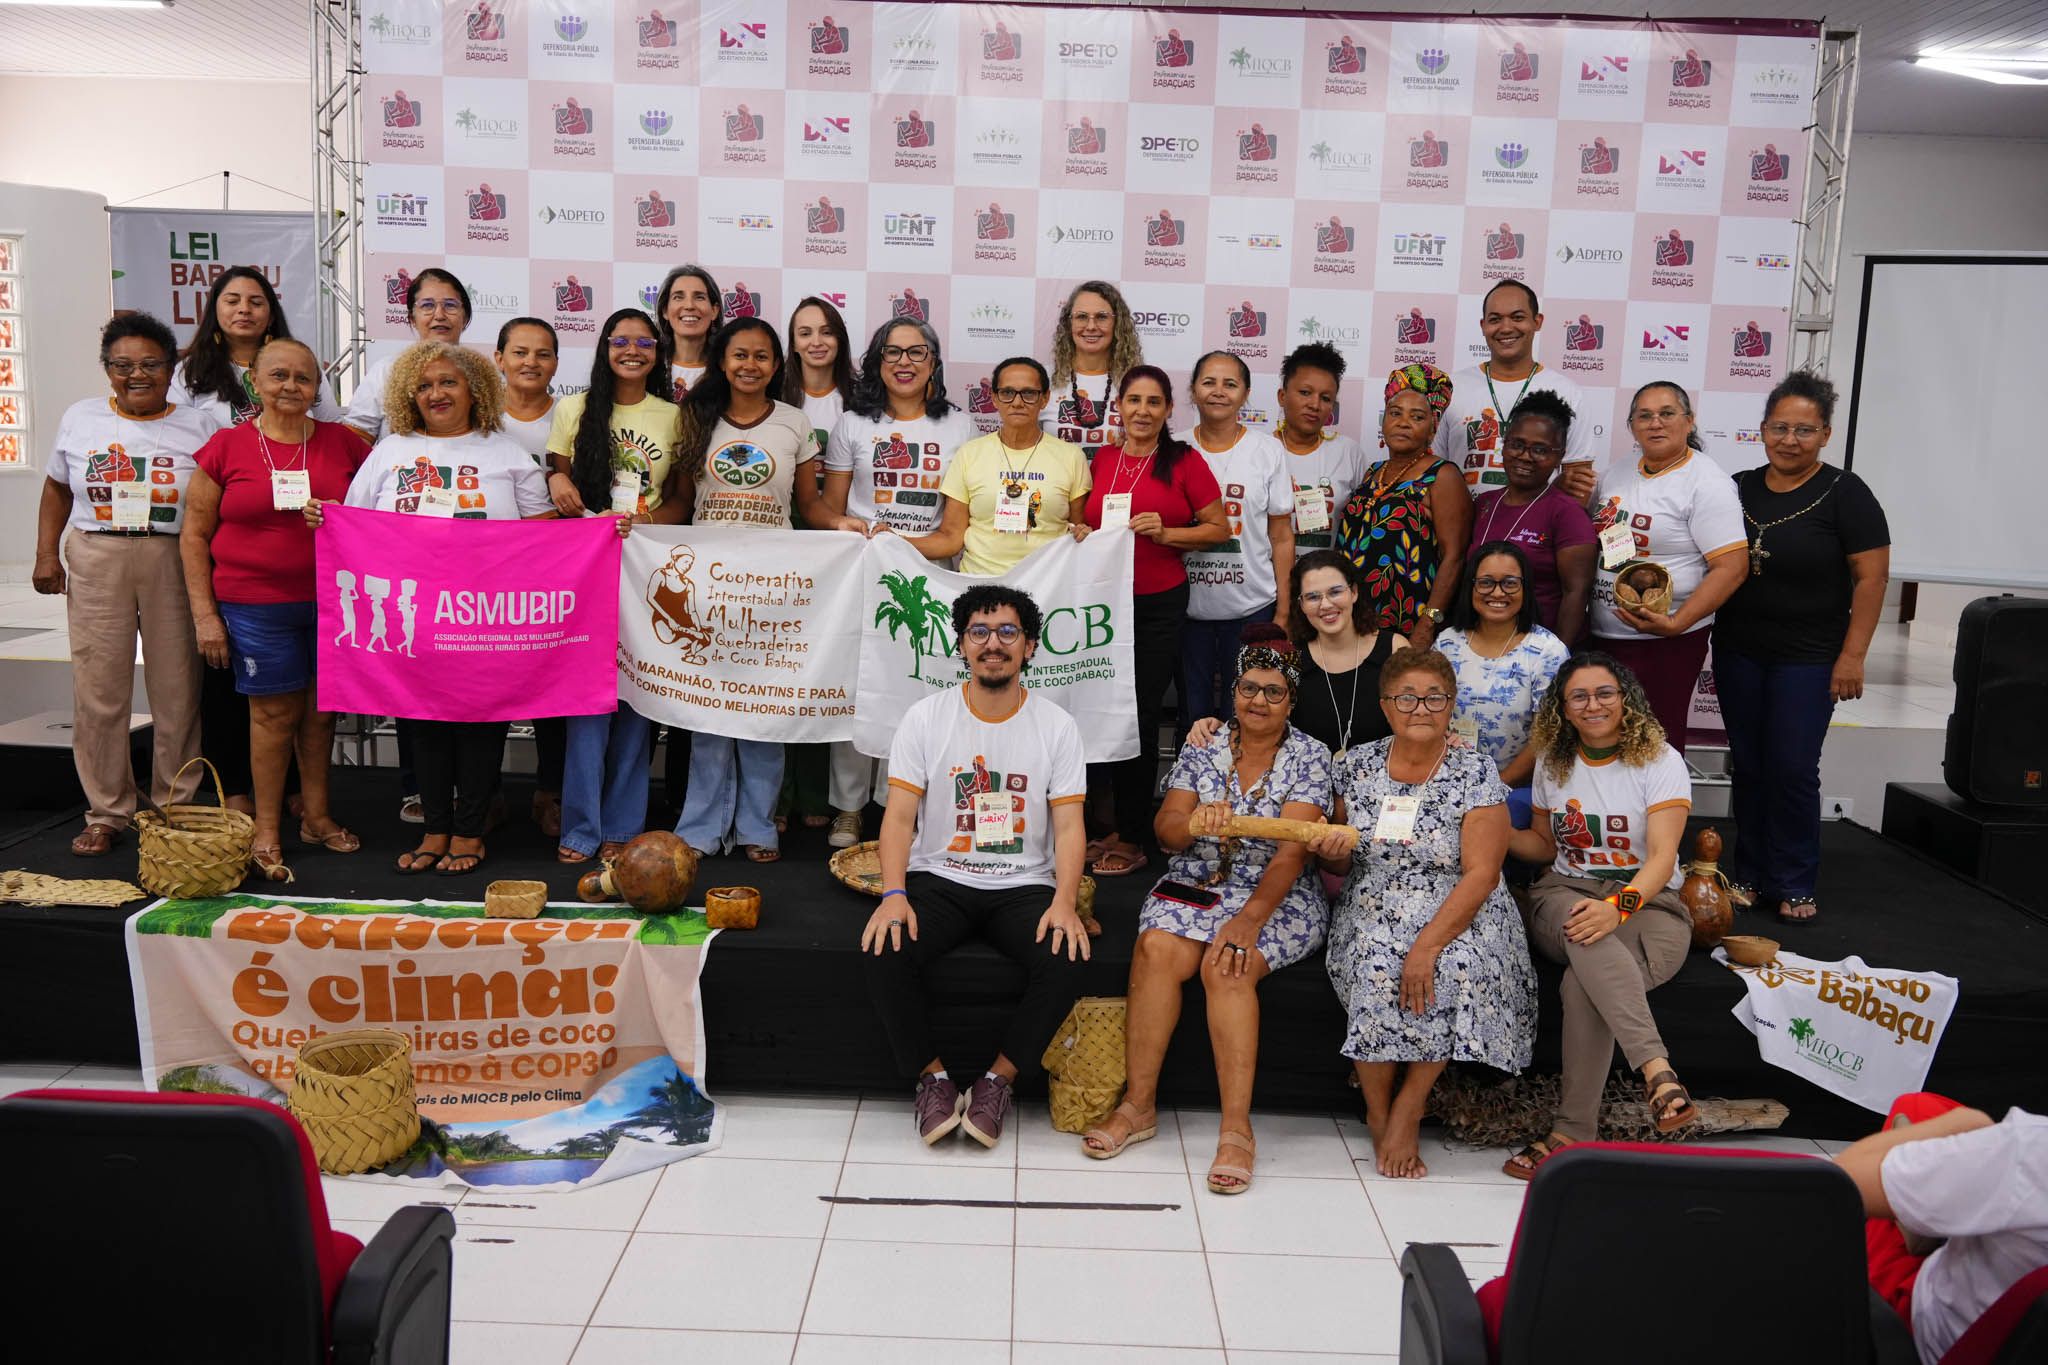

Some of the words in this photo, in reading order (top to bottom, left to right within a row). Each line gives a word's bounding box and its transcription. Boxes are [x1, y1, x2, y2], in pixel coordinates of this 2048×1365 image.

[542, 44, 576, 52] DEFENSORIA
[466, 52, 508, 63] BABAÇUAIS
[637, 58, 679, 70] BABAÇUAIS
[809, 65, 851, 76] BABAÇUAIS
[981, 71, 1023, 82] BABAÇUAIS
[1153, 78, 1195, 89] BABAÇUAIS
[1403, 76, 1436, 85] DEFENSORIA
[1325, 85, 1367, 96] BABAÇUAIS
[1497, 92, 1539, 102] BABAÇUAIS
[1668, 98, 1711, 109] BABAÇUAIS
[471, 117, 518, 132] MIQCB
[383, 138, 424, 149] BABAÇUAIS
[628, 137, 660, 146] DEFENSORIA
[553, 146, 596, 156] BABAÇUAIS
[724, 152, 766, 163] BABAÇUAIS
[894, 158, 936, 170] BABAÇUAIS
[1065, 165, 1108, 176] BABAÇUAIS
[1236, 171, 1278, 182] BABAÇUAIS
[1482, 170, 1514, 178] DEFENSORIA
[1406, 178, 1449, 188] BABAÇUAIS
[1577, 185, 1620, 196] BABAÇUAIS
[1747, 192, 1789, 202] BABAÇUAIS
[377, 198, 428, 216] UFNT
[558, 208, 605, 222] ADPETO
[884, 219, 936, 236] UFNT
[468, 232, 509, 242] BABAÇUAIS
[1066, 227, 1114, 242] ADPETO
[170, 232, 219, 260] LEI
[636, 238, 678, 248] BABAÇUAIS
[1394, 238, 1446, 256] UFNT
[806, 244, 846, 255] BABAÇUAIS
[1576, 248, 1622, 261] ADPETO
[974, 250, 1016, 262] BABAÇUAIS
[1144, 256, 1186, 268] BABAÇUAIS
[171, 262, 281, 288] BABU
[1314, 264, 1356, 274] BABAÇUAIS
[1653, 270, 1685, 278] Defensorias
[1652, 278, 1694, 288] BABAÇUAIS
[472, 294, 518, 309] MIQCB
[554, 322, 596, 332] BABAÇUAIS
[1468, 344, 1491, 352] DEFENS
[1562, 361, 1604, 372] BABAÇUAIS
[1731, 360, 1763, 368] Defensorias
[1730, 368, 1772, 378] BABAÇUAIS
[1000, 471, 1026, 480] FARM
[1028, 472, 1045, 481] RIO
[718, 492, 760, 500] ENCONTRÃO
[710, 510, 740, 521] COCO
[742, 512, 784, 528] BABAÇU
[1184, 557, 1229, 569] fensorias
[710, 562, 814, 592] Cooperativa
[1190, 570, 1244, 588] BAÇUAIS
[708, 584, 788, 606] Interestadual
[792, 592, 812, 607] das
[434, 590, 576, 626] ASMUBIP
[706, 604, 802, 634] Mulheres
[434, 632, 477, 642] ASSOCIAÇÃO
[478, 634, 512, 642] REGIONAL
[514, 634, 528, 642] DAS
[529, 630, 565, 640] MULHERES
[926, 604, 1114, 658] MCB
[434, 643, 494, 652] TRABALHADORAS
[495, 644, 520, 652] RURAIS
[532, 642, 548, 650] BICO
[550, 640, 558, 648] DO
[559, 634, 590, 646] PAPAGAIO
[715, 632, 809, 653] Quebradeiras
[712, 649, 724, 662] de
[730, 652, 760, 666] Coco
[765, 652, 804, 674] Babaçu
[1033, 656, 1112, 676] INTERESTADUAL
[637, 660, 715, 692] MARANHÃO,
[720, 680, 794, 698] TOCANTINS
[798, 688, 806, 699] E
[810, 686, 846, 700] PARÁ
[926, 676, 944, 688] DAS
[1028, 680, 1042, 688] DE
[1044, 676, 1074, 688] COCO
[1075, 668, 1116, 682] BABAÇU
[636, 676, 722, 709] CONSTRUINDO
[724, 700, 796, 716] MELHORIAS
[799, 706, 816, 717] DE
[820, 705, 856, 717] VIDAS
[232, 950, 290, 1018] é
[308, 958, 620, 1023] clima:
[1817, 978, 1936, 1046] Babaçu
[488, 1024, 530, 1048] de
[538, 1023, 616, 1046] coco
[1800, 1034, 1864, 1072] MIQCB
[480, 1054, 502, 1082] à
[510, 1046, 618, 1080] COP30
[440, 1094, 458, 1106] do
[461, 1092, 508, 1105] MIQCB
[510, 1090, 542, 1106] pelo
[544, 1088, 582, 1102] Clima
